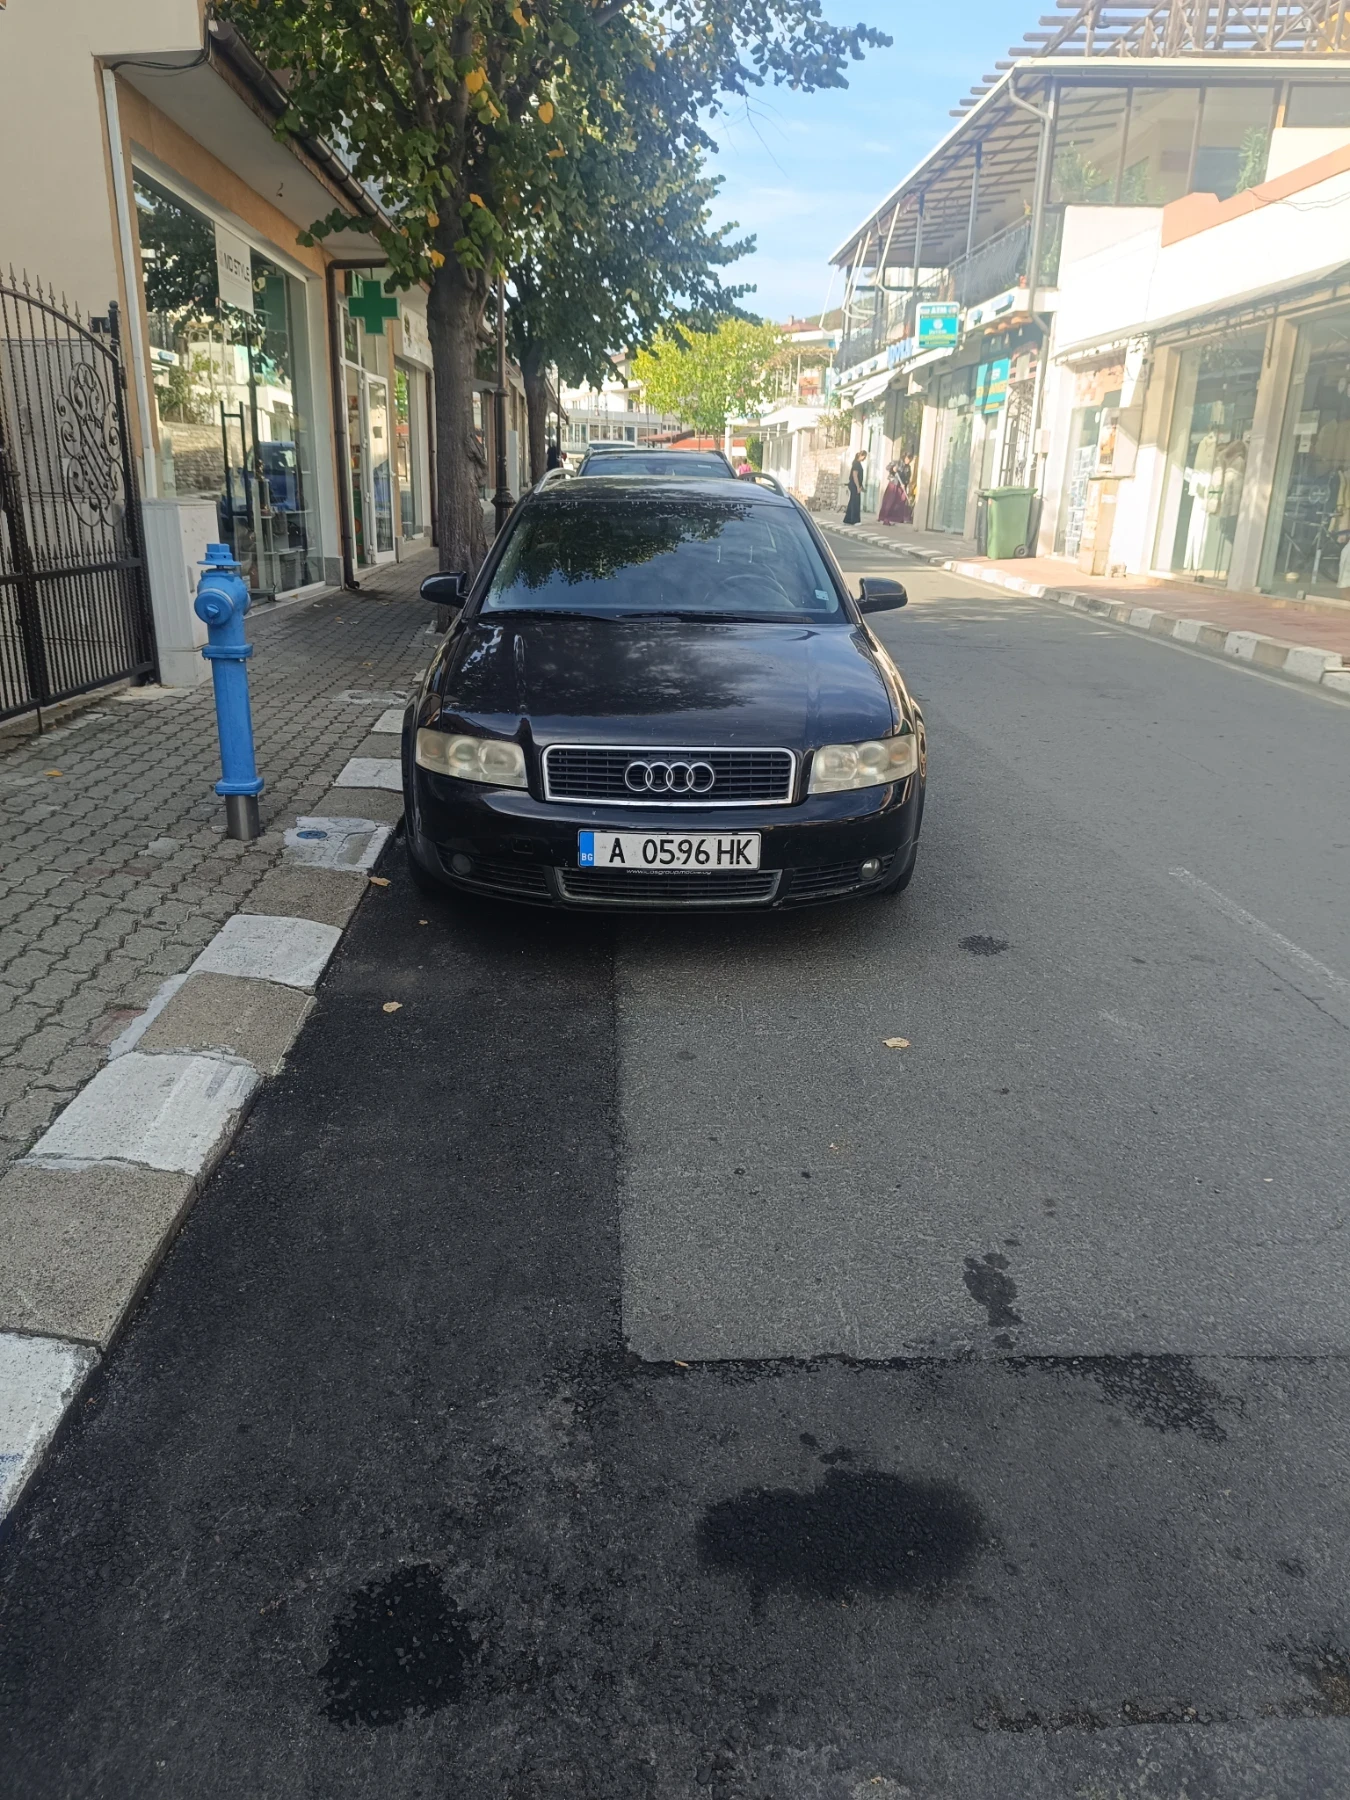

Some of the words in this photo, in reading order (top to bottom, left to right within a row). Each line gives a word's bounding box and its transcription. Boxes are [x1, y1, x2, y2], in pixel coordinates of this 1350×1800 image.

[581, 852, 593, 861] BG
[608, 837, 626, 864] A
[642, 838, 711, 865] 0596
[716, 838, 753, 865] HK
